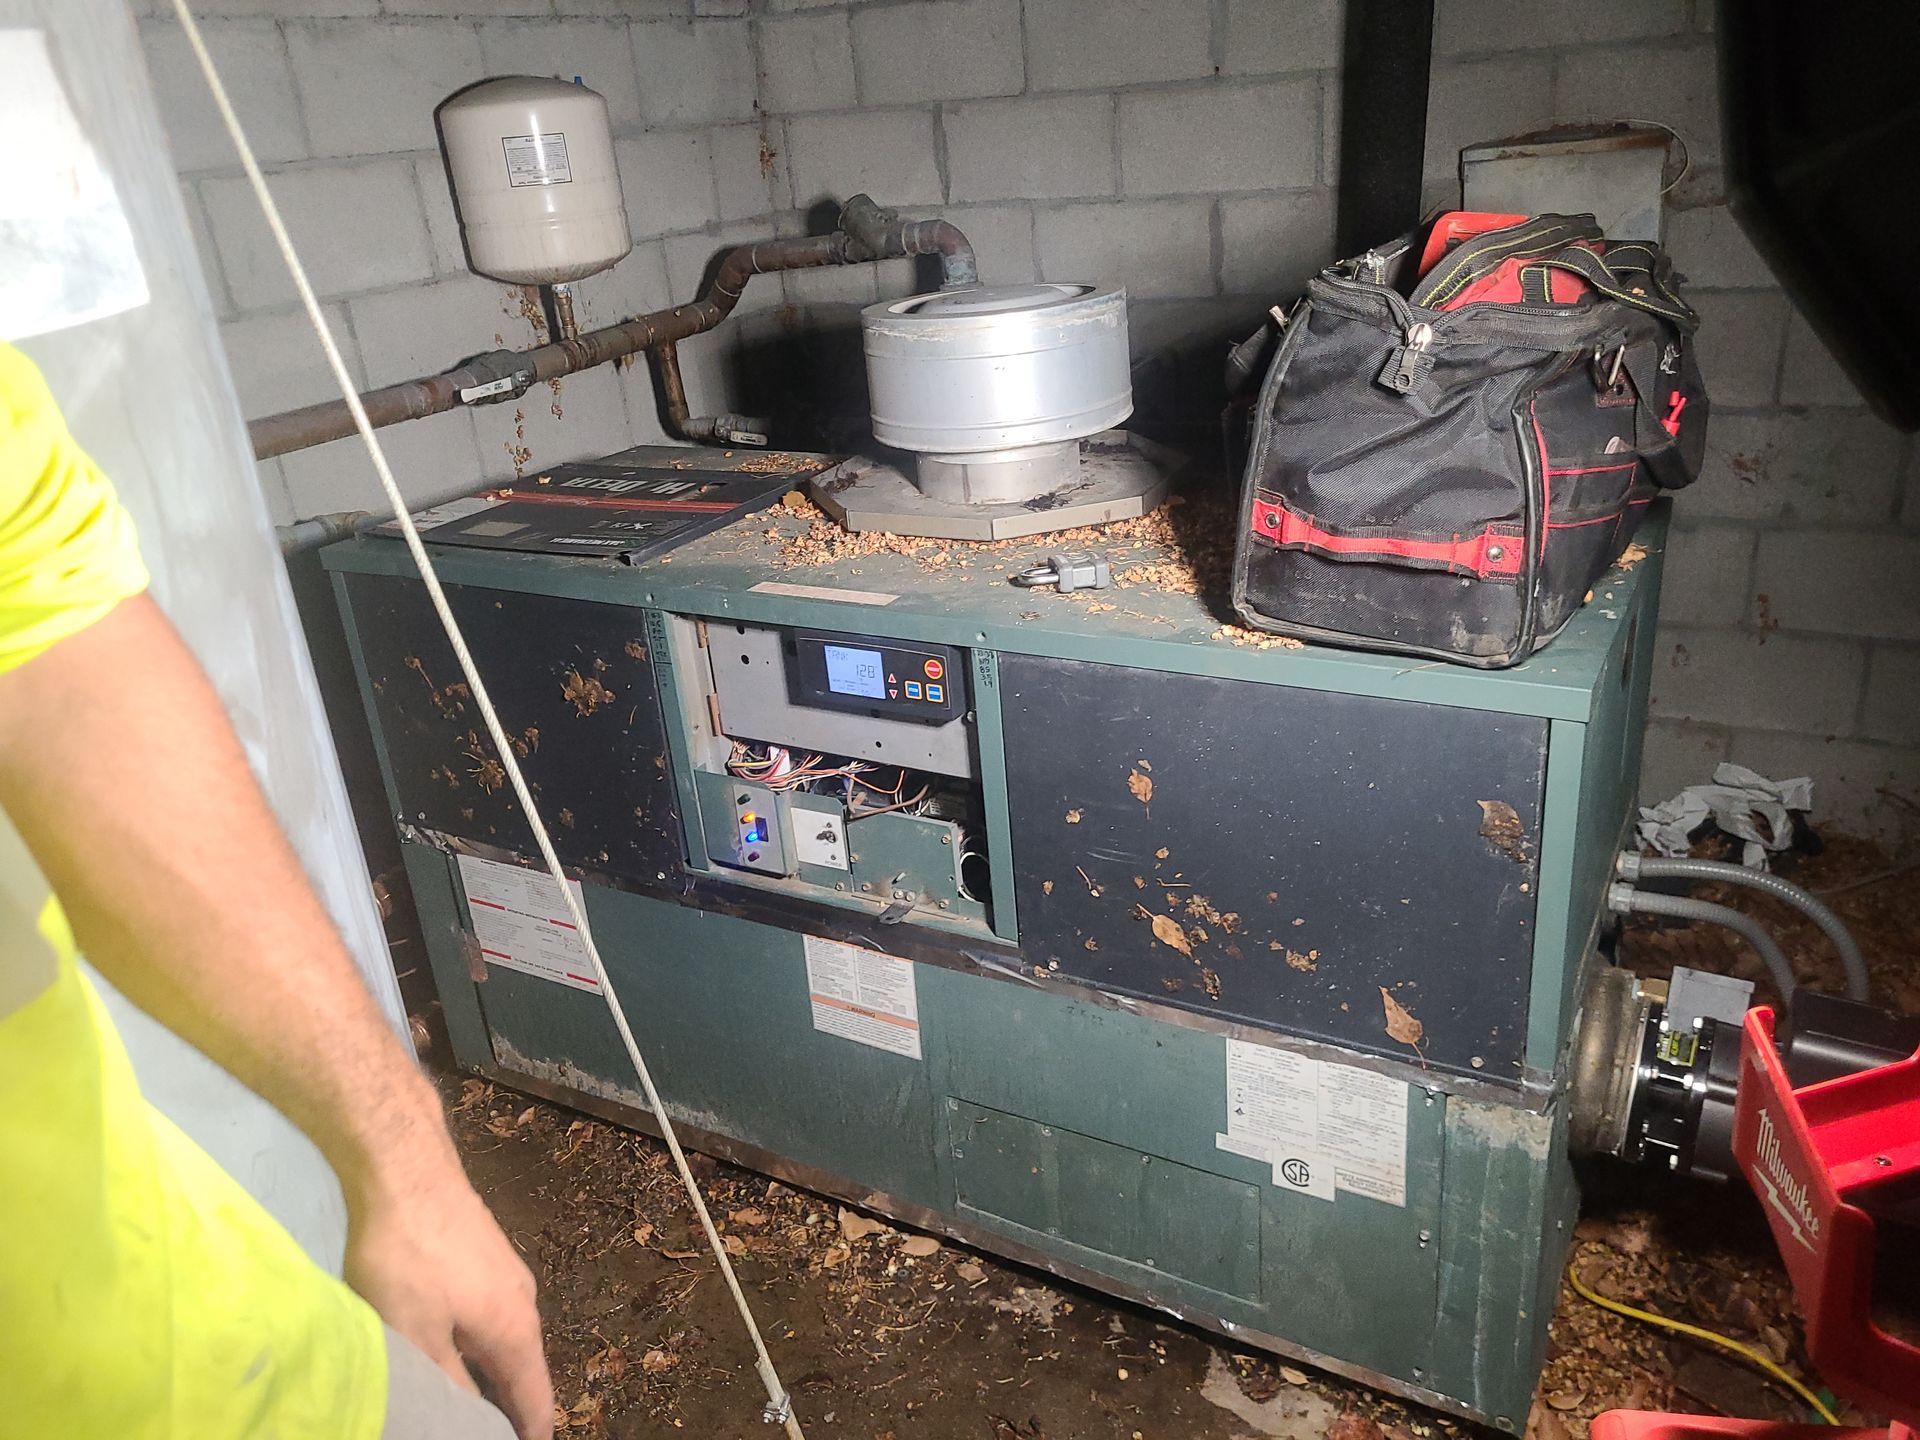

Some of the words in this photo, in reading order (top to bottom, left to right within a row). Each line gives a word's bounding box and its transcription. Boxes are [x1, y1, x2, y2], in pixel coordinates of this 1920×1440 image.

[559, 477, 648, 492] DELTA
[649, 482, 697, 494] HI
[856, 664, 875, 679] 128
[1757, 1108, 1820, 1240] Milwaukee
